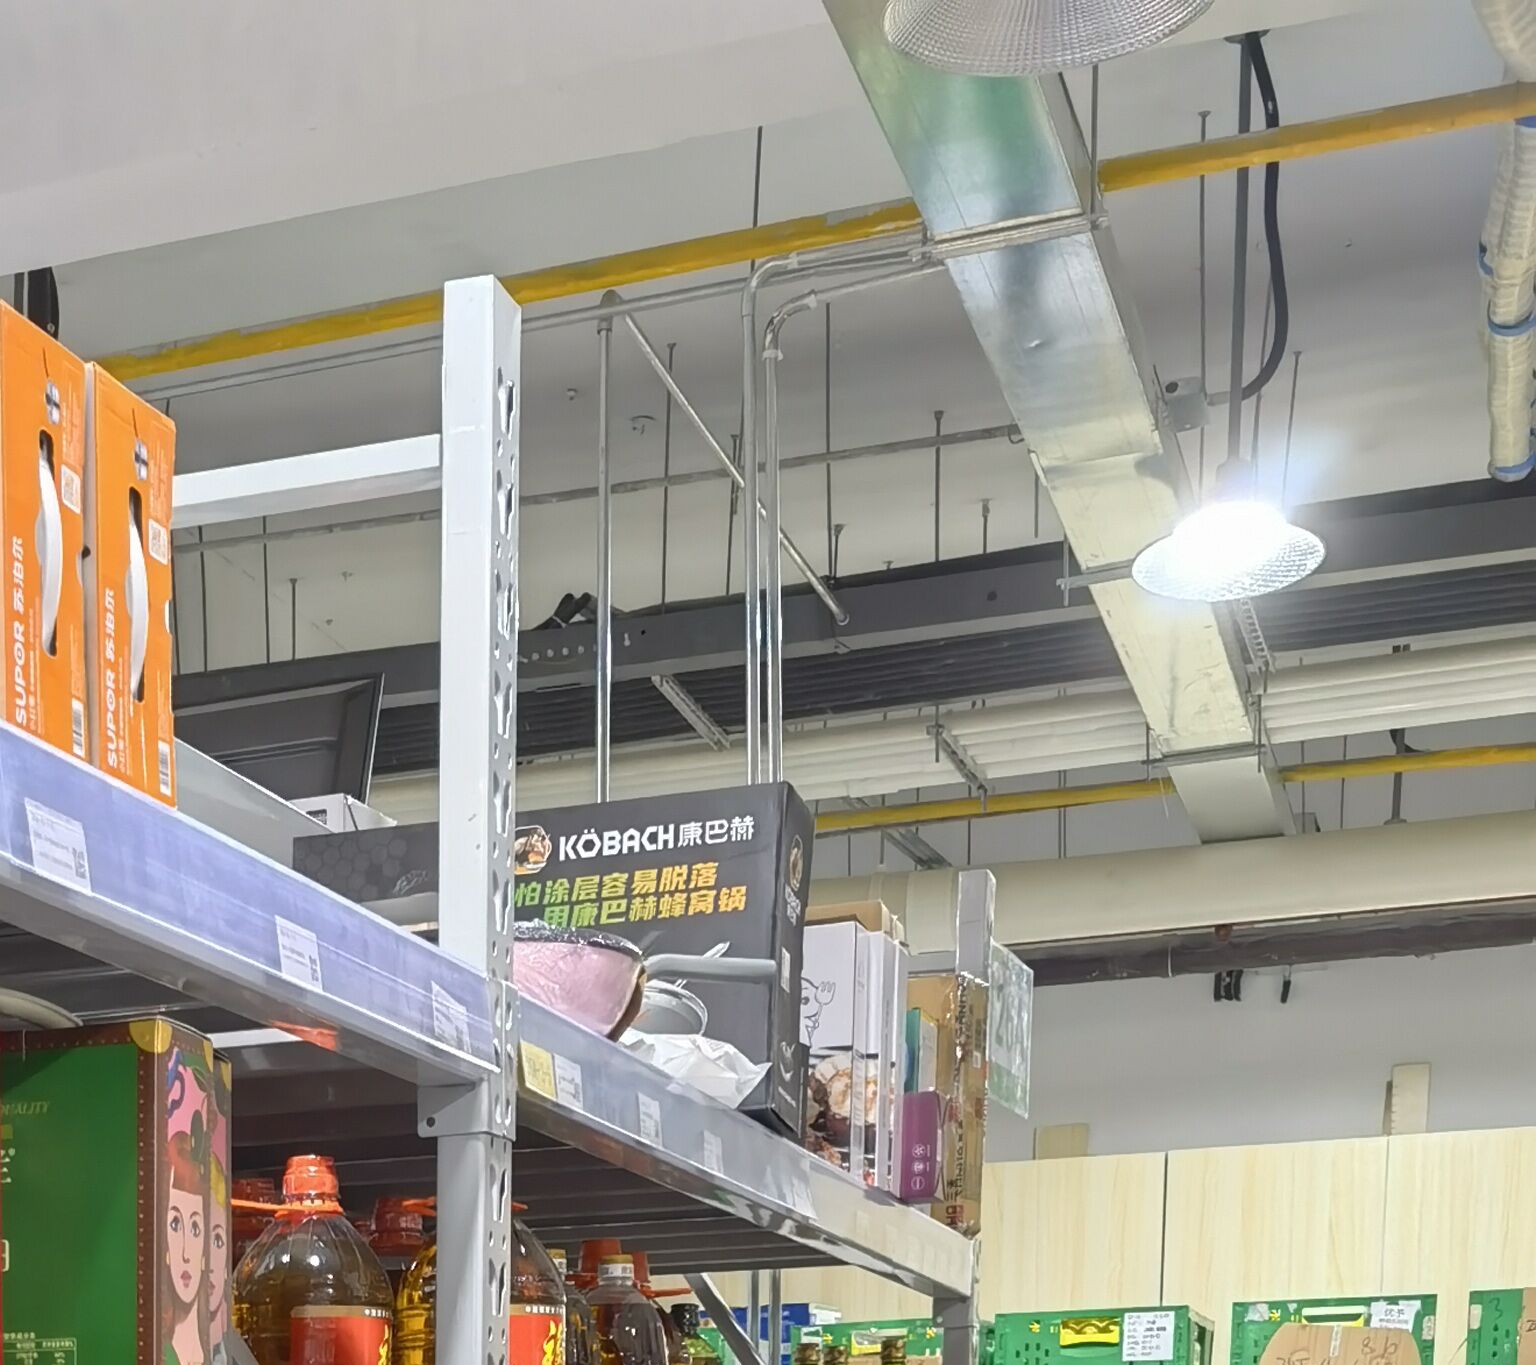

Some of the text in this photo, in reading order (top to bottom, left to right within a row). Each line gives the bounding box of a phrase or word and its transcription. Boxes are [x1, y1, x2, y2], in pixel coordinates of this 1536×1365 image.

[14, 622, 27, 726] SUPOR
[105, 671, 117, 768] SUPOR
[558, 815, 755, 862] KÖBACH 康巴赫
[515, 861, 719, 908] 怕涂层容易脱落
[543, 885, 747, 928] 用康巴赫蜂窝锅
